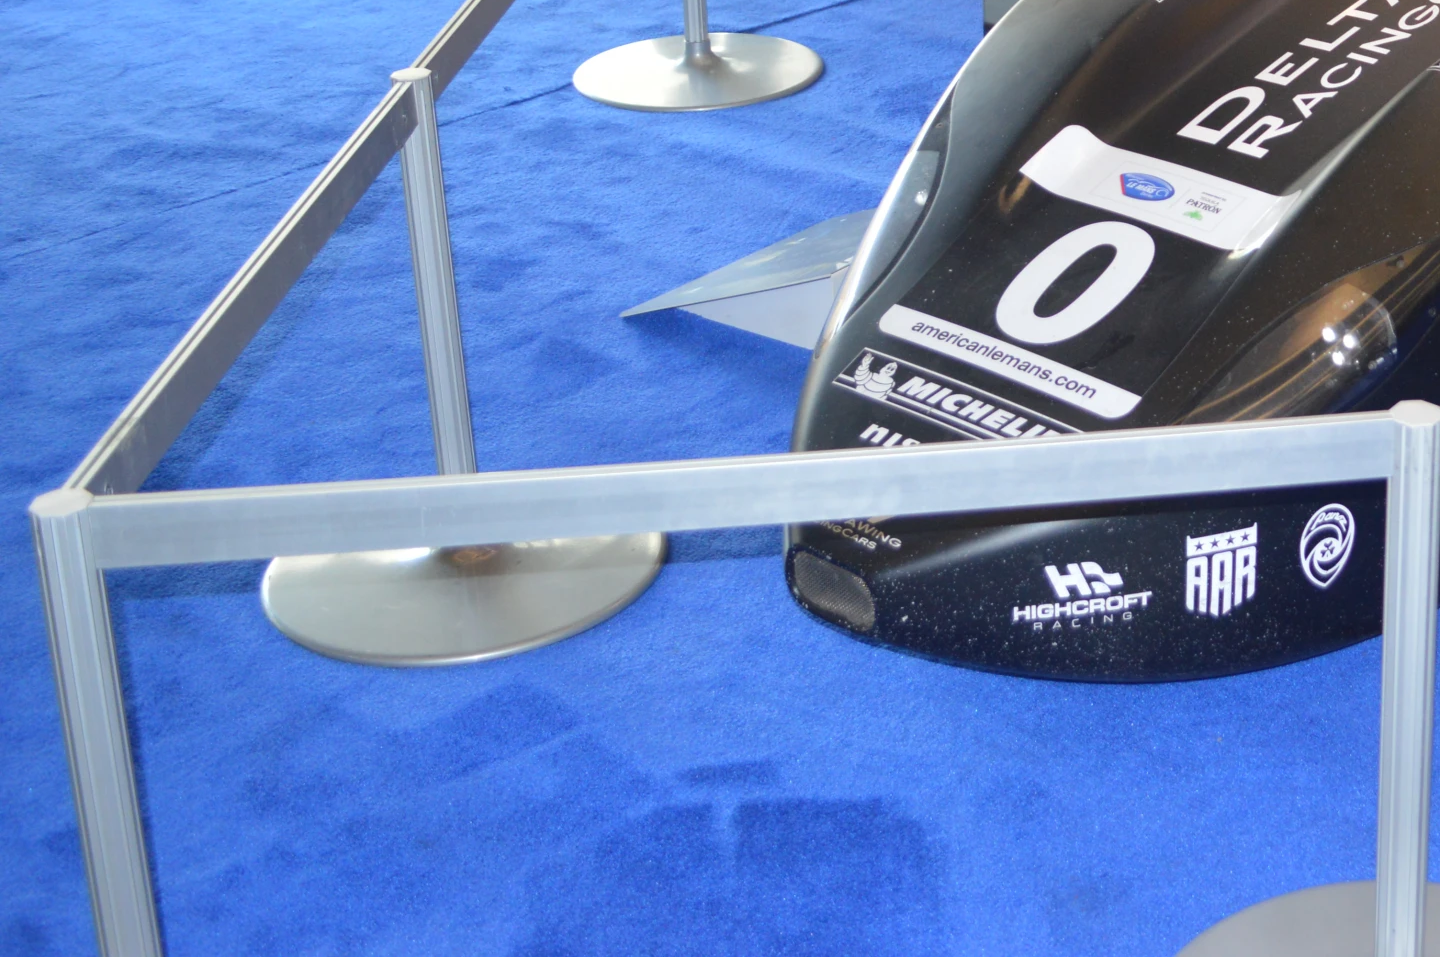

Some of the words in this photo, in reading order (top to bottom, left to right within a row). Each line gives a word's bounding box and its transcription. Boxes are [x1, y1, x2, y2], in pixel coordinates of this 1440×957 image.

[996, 221, 1155, 344] 0
[911, 320, 1097, 399] americanlemans.com
[1013, 591, 1153, 622] HIGHCROFT
[1187, 545, 1257, 617] AAR
[1033, 611, 1133, 631] RACING
